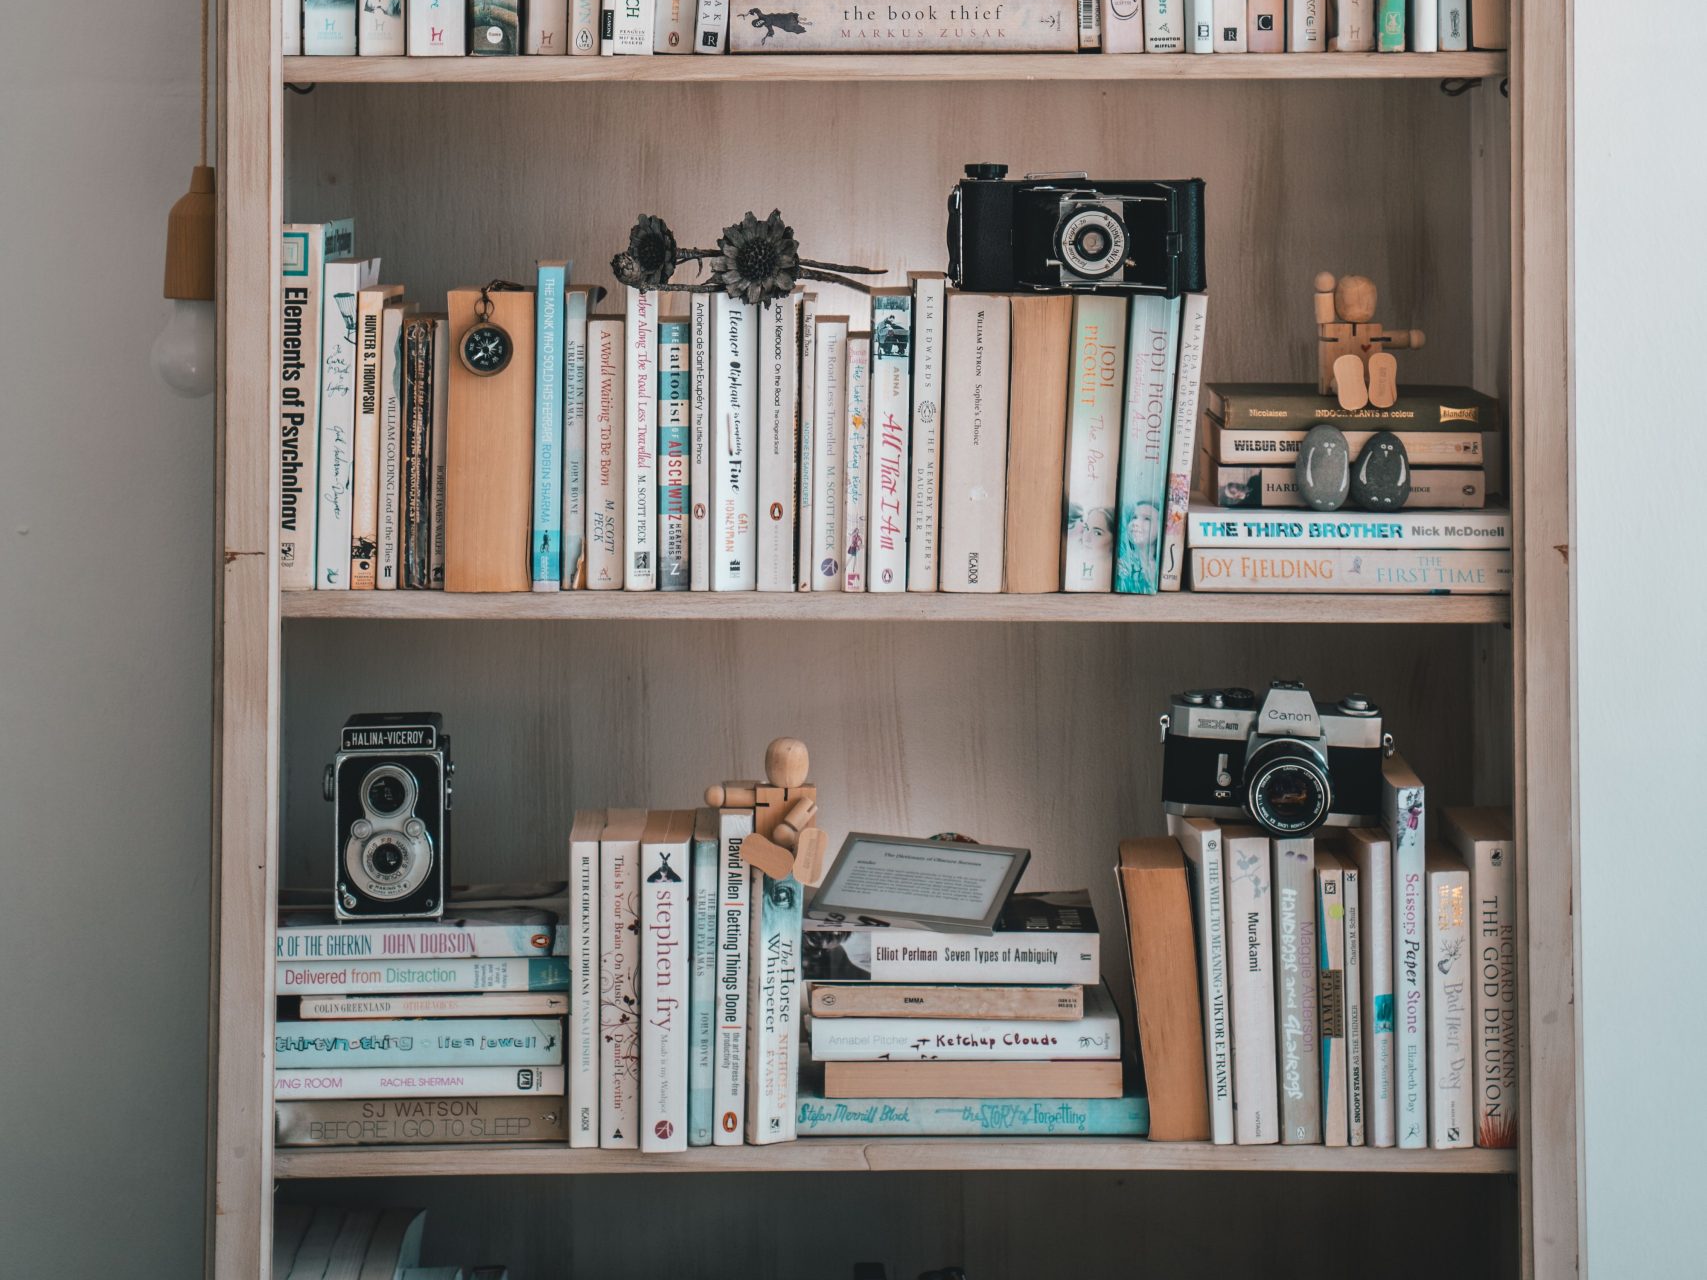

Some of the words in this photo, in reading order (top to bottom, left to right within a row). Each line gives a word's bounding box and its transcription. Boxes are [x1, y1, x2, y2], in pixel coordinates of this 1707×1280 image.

[843, 6, 875, 20] the
[888, 5, 937, 20] book
[950, 4, 1003, 20] thief
[841, 29, 925, 38] MARKUS
[940, 29, 1006, 38] ZUSAK
[696, 302, 704, 335] Antoine
[926, 296, 934, 320] KIM
[284, 287, 308, 382] Elements
[365, 315, 377, 350] HUNTER
[601, 331, 610, 340] A
[671, 326, 680, 344] THE
[696, 337, 704, 349] de
[729, 310, 743, 356] Eleanor
[364, 352, 376, 360] S.
[600, 340, 616, 376] World
[1081, 325, 1098, 407] PICOULT
[1100, 345, 1116, 388] JODI
[1149, 329, 1167, 373] JODI
[363, 363, 375, 414] THOMPSON
[670, 346, 684, 424] tattooist
[694, 350, 705, 410] Saint-Exupéry
[729, 361, 742, 408] Oliphant
[283, 386, 304, 408] of
[597, 378, 613, 423] Waiting
[600, 425, 611, 440] To
[671, 427, 678, 438] OF
[1088, 416, 1104, 440] The
[1144, 384, 1163, 464] PICOULT
[601, 442, 611, 456] Be
[1087, 450, 1103, 480] Pact
[601, 458, 611, 486] Born
[668, 440, 683, 521] AUSCHWITZ
[730, 460, 743, 493] Fine
[594, 512, 604, 542] PECK
[1200, 522, 1238, 538] THE
[1244, 523, 1303, 538] THIRD
[1309, 523, 1403, 538] BROTHER
[1412, 526, 1441, 537] Nick
[1444, 526, 1504, 537] McDonell
[968, 553, 979, 584] PICADOR
[1200, 557, 1238, 581] JOY
[1241, 558, 1334, 580] FIELDING
[1377, 567, 1428, 583] FIRST
[1431, 567, 1486, 583] TIME
[1226, 723, 1238, 731] AUTO
[1268, 709, 1312, 722] Canon
[352, 731, 424, 746] HALINA-VICEROY
[728, 838, 743, 868] David
[728, 872, 743, 899] Allen
[1405, 873, 1420, 935] Scissors
[1482, 895, 1498, 937] THE
[287, 936, 300, 957] OF
[304, 935, 323, 956] THE
[326, 934, 372, 956] GHERKIN
[382, 934, 416, 954] JOHN
[420, 933, 476, 954] DOBSON
[723, 909, 742, 951] Getting
[1248, 912, 1261, 972] Murakami
[780, 940, 793, 966] The
[876, 948, 898, 961] Elliot
[902, 948, 938, 961] Perlman
[944, 948, 970, 962] Seven
[974, 949, 999, 964] Types
[1002, 949, 1011, 962] of
[1014, 949, 1058, 965] Ambiguity
[1299, 921, 1314, 979] Maggie
[1403, 939, 1420, 985] Paper
[1500, 925, 1514, 1002] RICHARD
[285, 970, 346, 985] Delivered
[351, 970, 382, 984] from
[386, 968, 456, 983] Distraction
[724, 953, 741, 990] Things
[762, 933, 780, 1033] Whisperer
[1483, 946, 1499, 996] GOD
[314, 1003, 338, 1013] COLIN
[340, 1002, 391, 1012] GREENLAND
[725, 993, 740, 1022] Done
[779, 968, 795, 1023] Horse
[1407, 990, 1420, 1034] Stone
[1302, 984, 1315, 1052] Alderson
[722, 1032, 731, 1069] productivity
[1484, 1008, 1502, 1118] DELUSION
[1501, 1010, 1516, 1088] DAWKINS
[1407, 1044, 1417, 1090] Elizabeth
[362, 1103, 386, 1118] SJ
[395, 1101, 478, 1116] WATSON
[1405, 1092, 1417, 1113] Day
